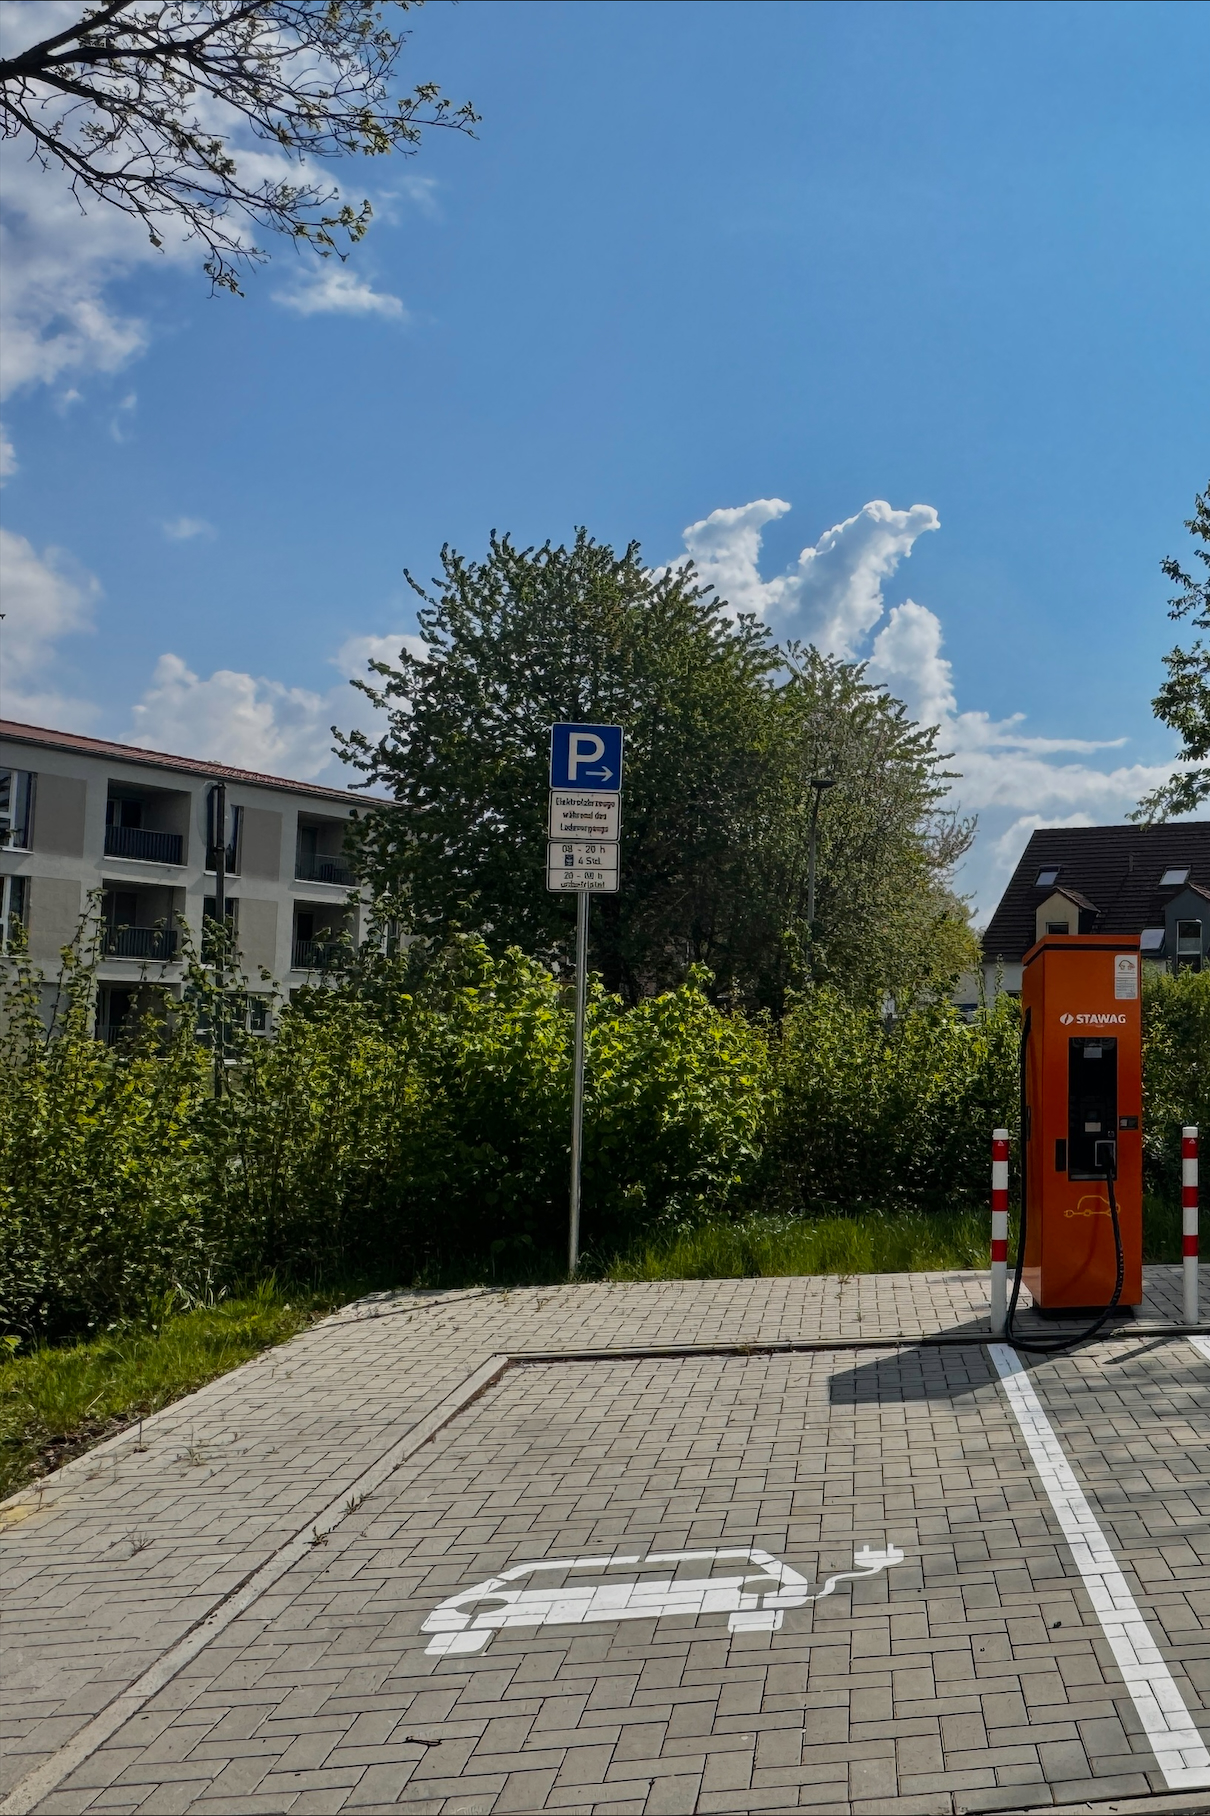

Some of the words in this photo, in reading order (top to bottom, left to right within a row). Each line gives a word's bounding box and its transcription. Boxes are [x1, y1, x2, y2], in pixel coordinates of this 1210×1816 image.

[568, 732, 605, 781] P
[562, 844, 573, 853] 08
[585, 845, 596, 853] 20
[600, 845, 606, 853] h
[1076, 1014, 1126, 1024] STAWAG
